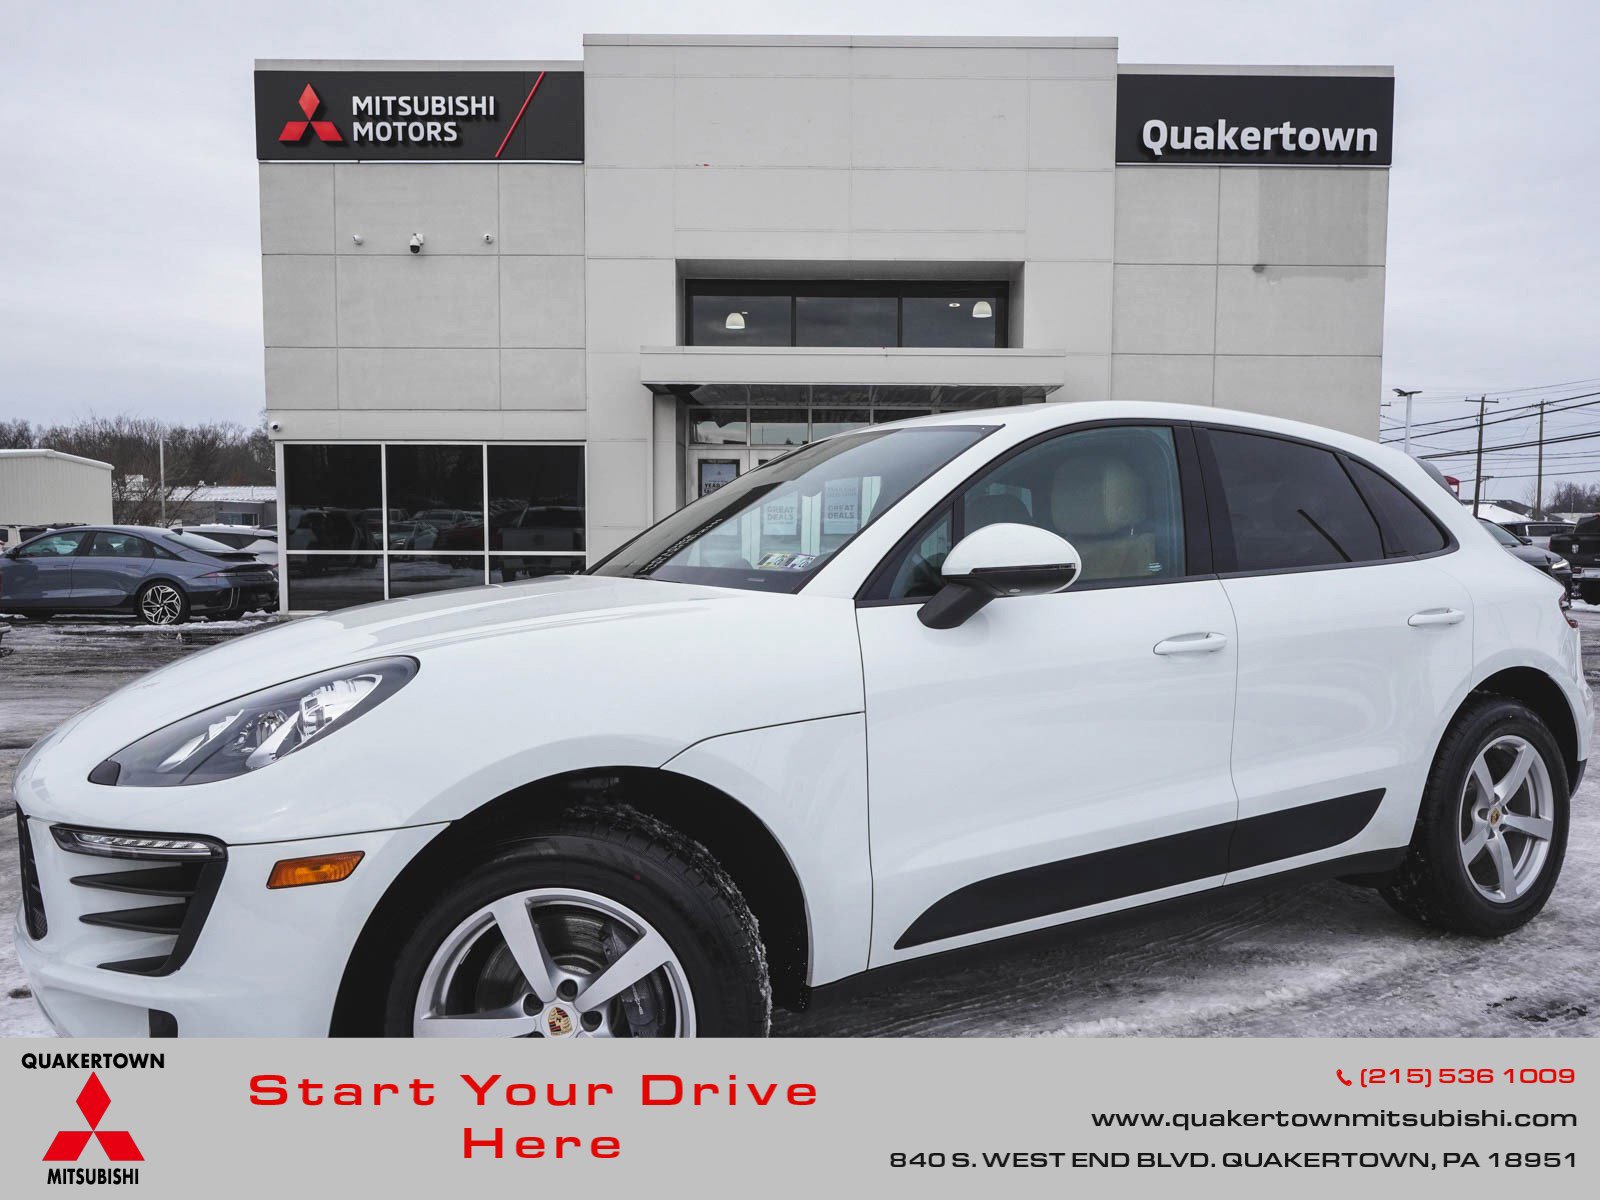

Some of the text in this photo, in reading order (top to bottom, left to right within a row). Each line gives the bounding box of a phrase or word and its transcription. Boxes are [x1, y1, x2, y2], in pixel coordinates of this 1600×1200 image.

[351, 95, 495, 116] MITSUBISHI
[352, 121, 458, 142] MOTORS
[1142, 118, 1378, 156] Quakertown
[827, 511, 855, 519] DEALS
